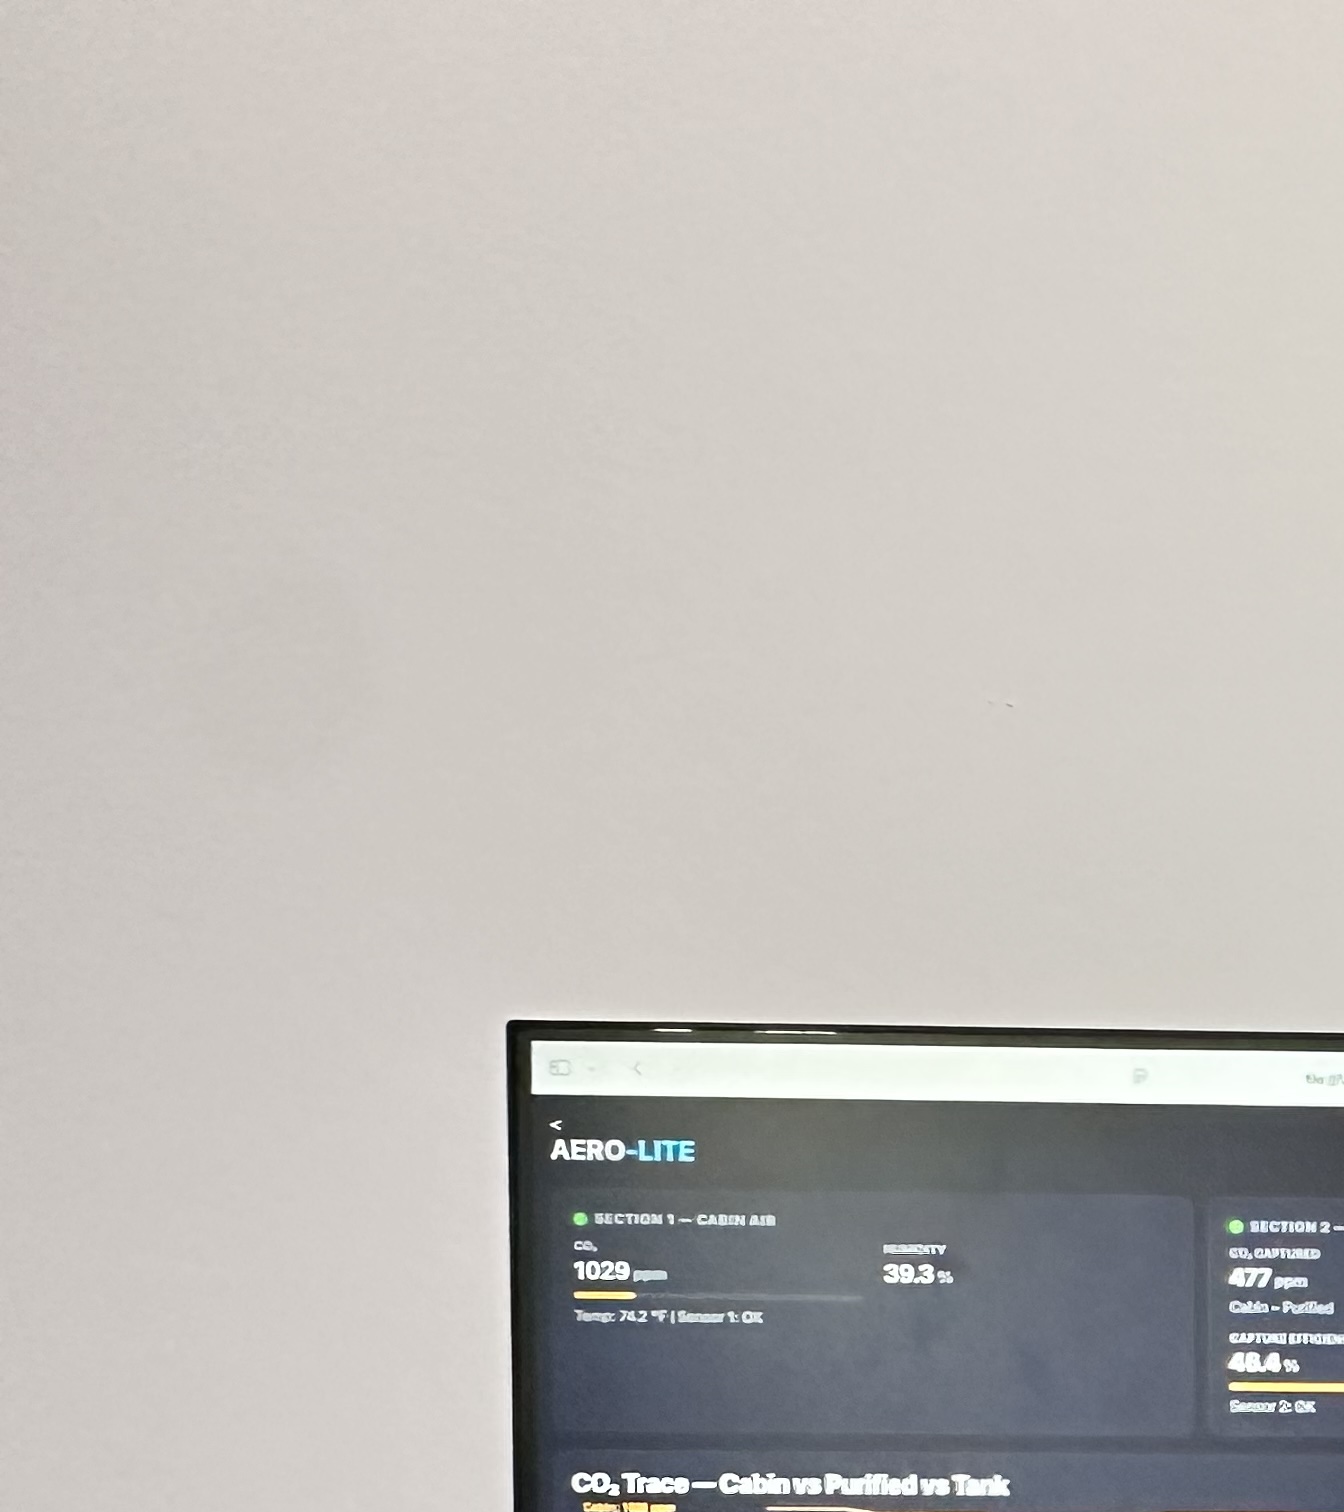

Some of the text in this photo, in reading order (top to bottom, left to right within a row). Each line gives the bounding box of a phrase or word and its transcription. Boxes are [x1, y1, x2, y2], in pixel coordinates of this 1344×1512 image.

[550, 1138, 696, 1163] AERO-LITE
[594, 1212, 663, 1226] SECTION
[1249, 1220, 1317, 1234] SECTION
[1319, 1221, 1331, 1234] 2
[573, 1260, 631, 1281] 1029
[882, 1263, 935, 1285] 39.3
[1227, 1267, 1273, 1289] 477
[620, 1472, 691, 1495] Trace
[717, 1472, 791, 1495] Cabin
[791, 1476, 823, 1495] vs
[823, 1472, 919, 1496] Purified
[919, 1477, 951, 1497] vs
[951, 1473, 1011, 1497] Tank
